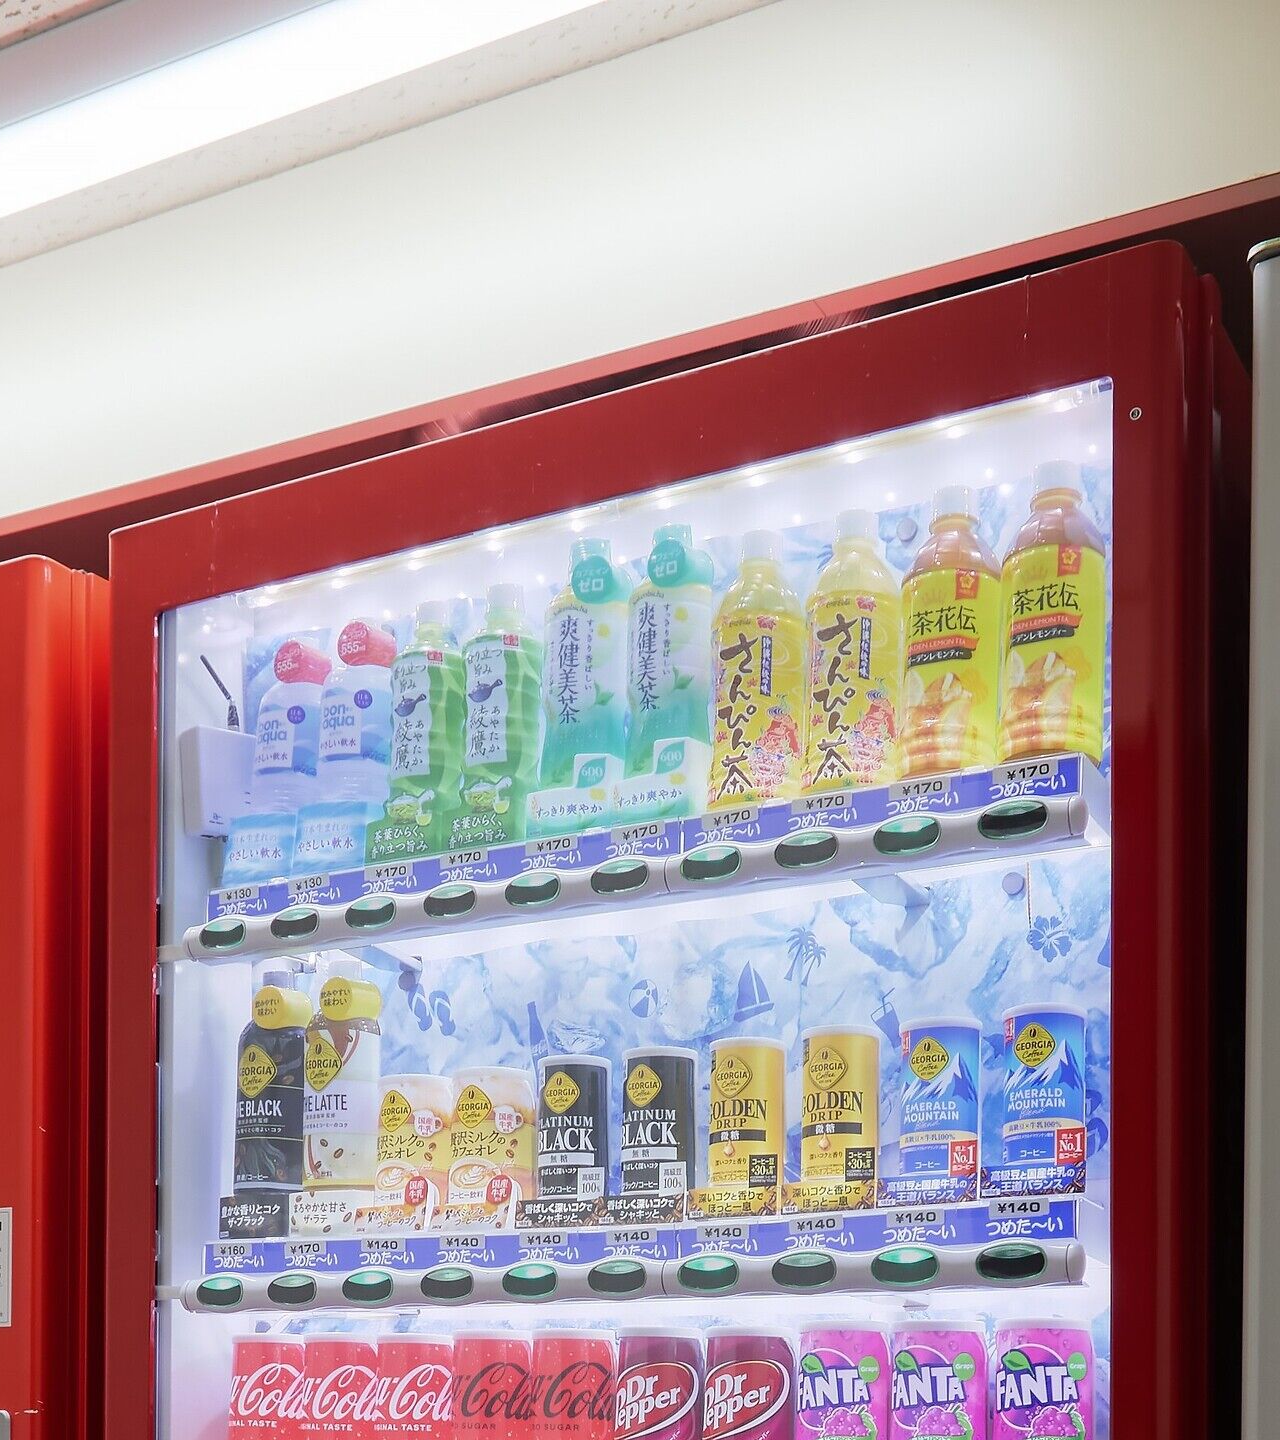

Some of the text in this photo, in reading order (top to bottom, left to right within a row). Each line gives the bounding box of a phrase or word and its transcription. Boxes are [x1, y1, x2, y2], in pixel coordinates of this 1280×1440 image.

[652, 560, 678, 576] ゼロ
[578, 580, 604, 593] ゼロ
[638, 601, 659, 712] 爽健美茶
[558, 614, 581, 725] 爽健美茶
[813, 613, 858, 784] さんぴん茶
[718, 633, 758, 801] さんぴん茶
[617, 788, 682, 807] すっきり爽やか
[535, 804, 603, 819] すっきり爽やか
[713, 810, 751, 824] ¥170
[622, 825, 658, 839] ¥170
[537, 838, 571, 851] ¥170
[1015, 1040, 1053, 1051] GEORGIA
[911, 1054, 947, 1064] GEORGIA
[1010, 1088, 1062, 1101] EMERALD
[245, 1099, 283, 1117] BLACK
[315, 1094, 347, 1111] LATTE
[906, 1101, 956, 1113] EMERALD
[1008, 1097, 1065, 1111] MOUNTAIN
[810, 1111, 843, 1122] DRIP
[904, 1111, 959, 1123] MOUNTAIN
[716, 1118, 747, 1129] DRIP
[720, 1130, 740, 1141] 微糖
[451, 1144, 498, 1159] カフェオレ
[1020, 1148, 1047, 1158] コーヒー
[915, 1159, 940, 1169] コーヒー
[990, 1168, 1075, 1182] 高級豆と国産牛乳の
[886, 1180, 967, 1193] 高級豆と国産牛乳の
[1000, 1179, 1063, 1191] 王道バランス
[698, 1190, 763, 1204] 深いコクと香りで
[896, 1191, 956, 1201] 王道バランス
[220, 1203, 280, 1219] 豊かな香りとコク
[294, 1202, 347, 1214] まろやかな甘さ
[525, 1202, 593, 1216] 香ばしく深いコクで
[607, 1198, 675, 1212] 香ばしく深いコクで
[708, 1201, 752, 1213] ほっと一息
[997, 1201, 1041, 1213] ¥140
[227, 1215, 265, 1228] ザ・ブラック
[302, 1213, 328, 1224] ザ・ラテ
[896, 1211, 937, 1223] ¥140
[220, 1245, 245, 1256] ¥160
[290, 1243, 320, 1254] ¥170
[624, 1373, 659, 1397] Dr
[713, 1372, 748, 1396] Dr
[798, 1368, 868, 1412] FANTA
[997, 1365, 1078, 1410] FANTA
[401, 1424, 432, 1432] TASTE
